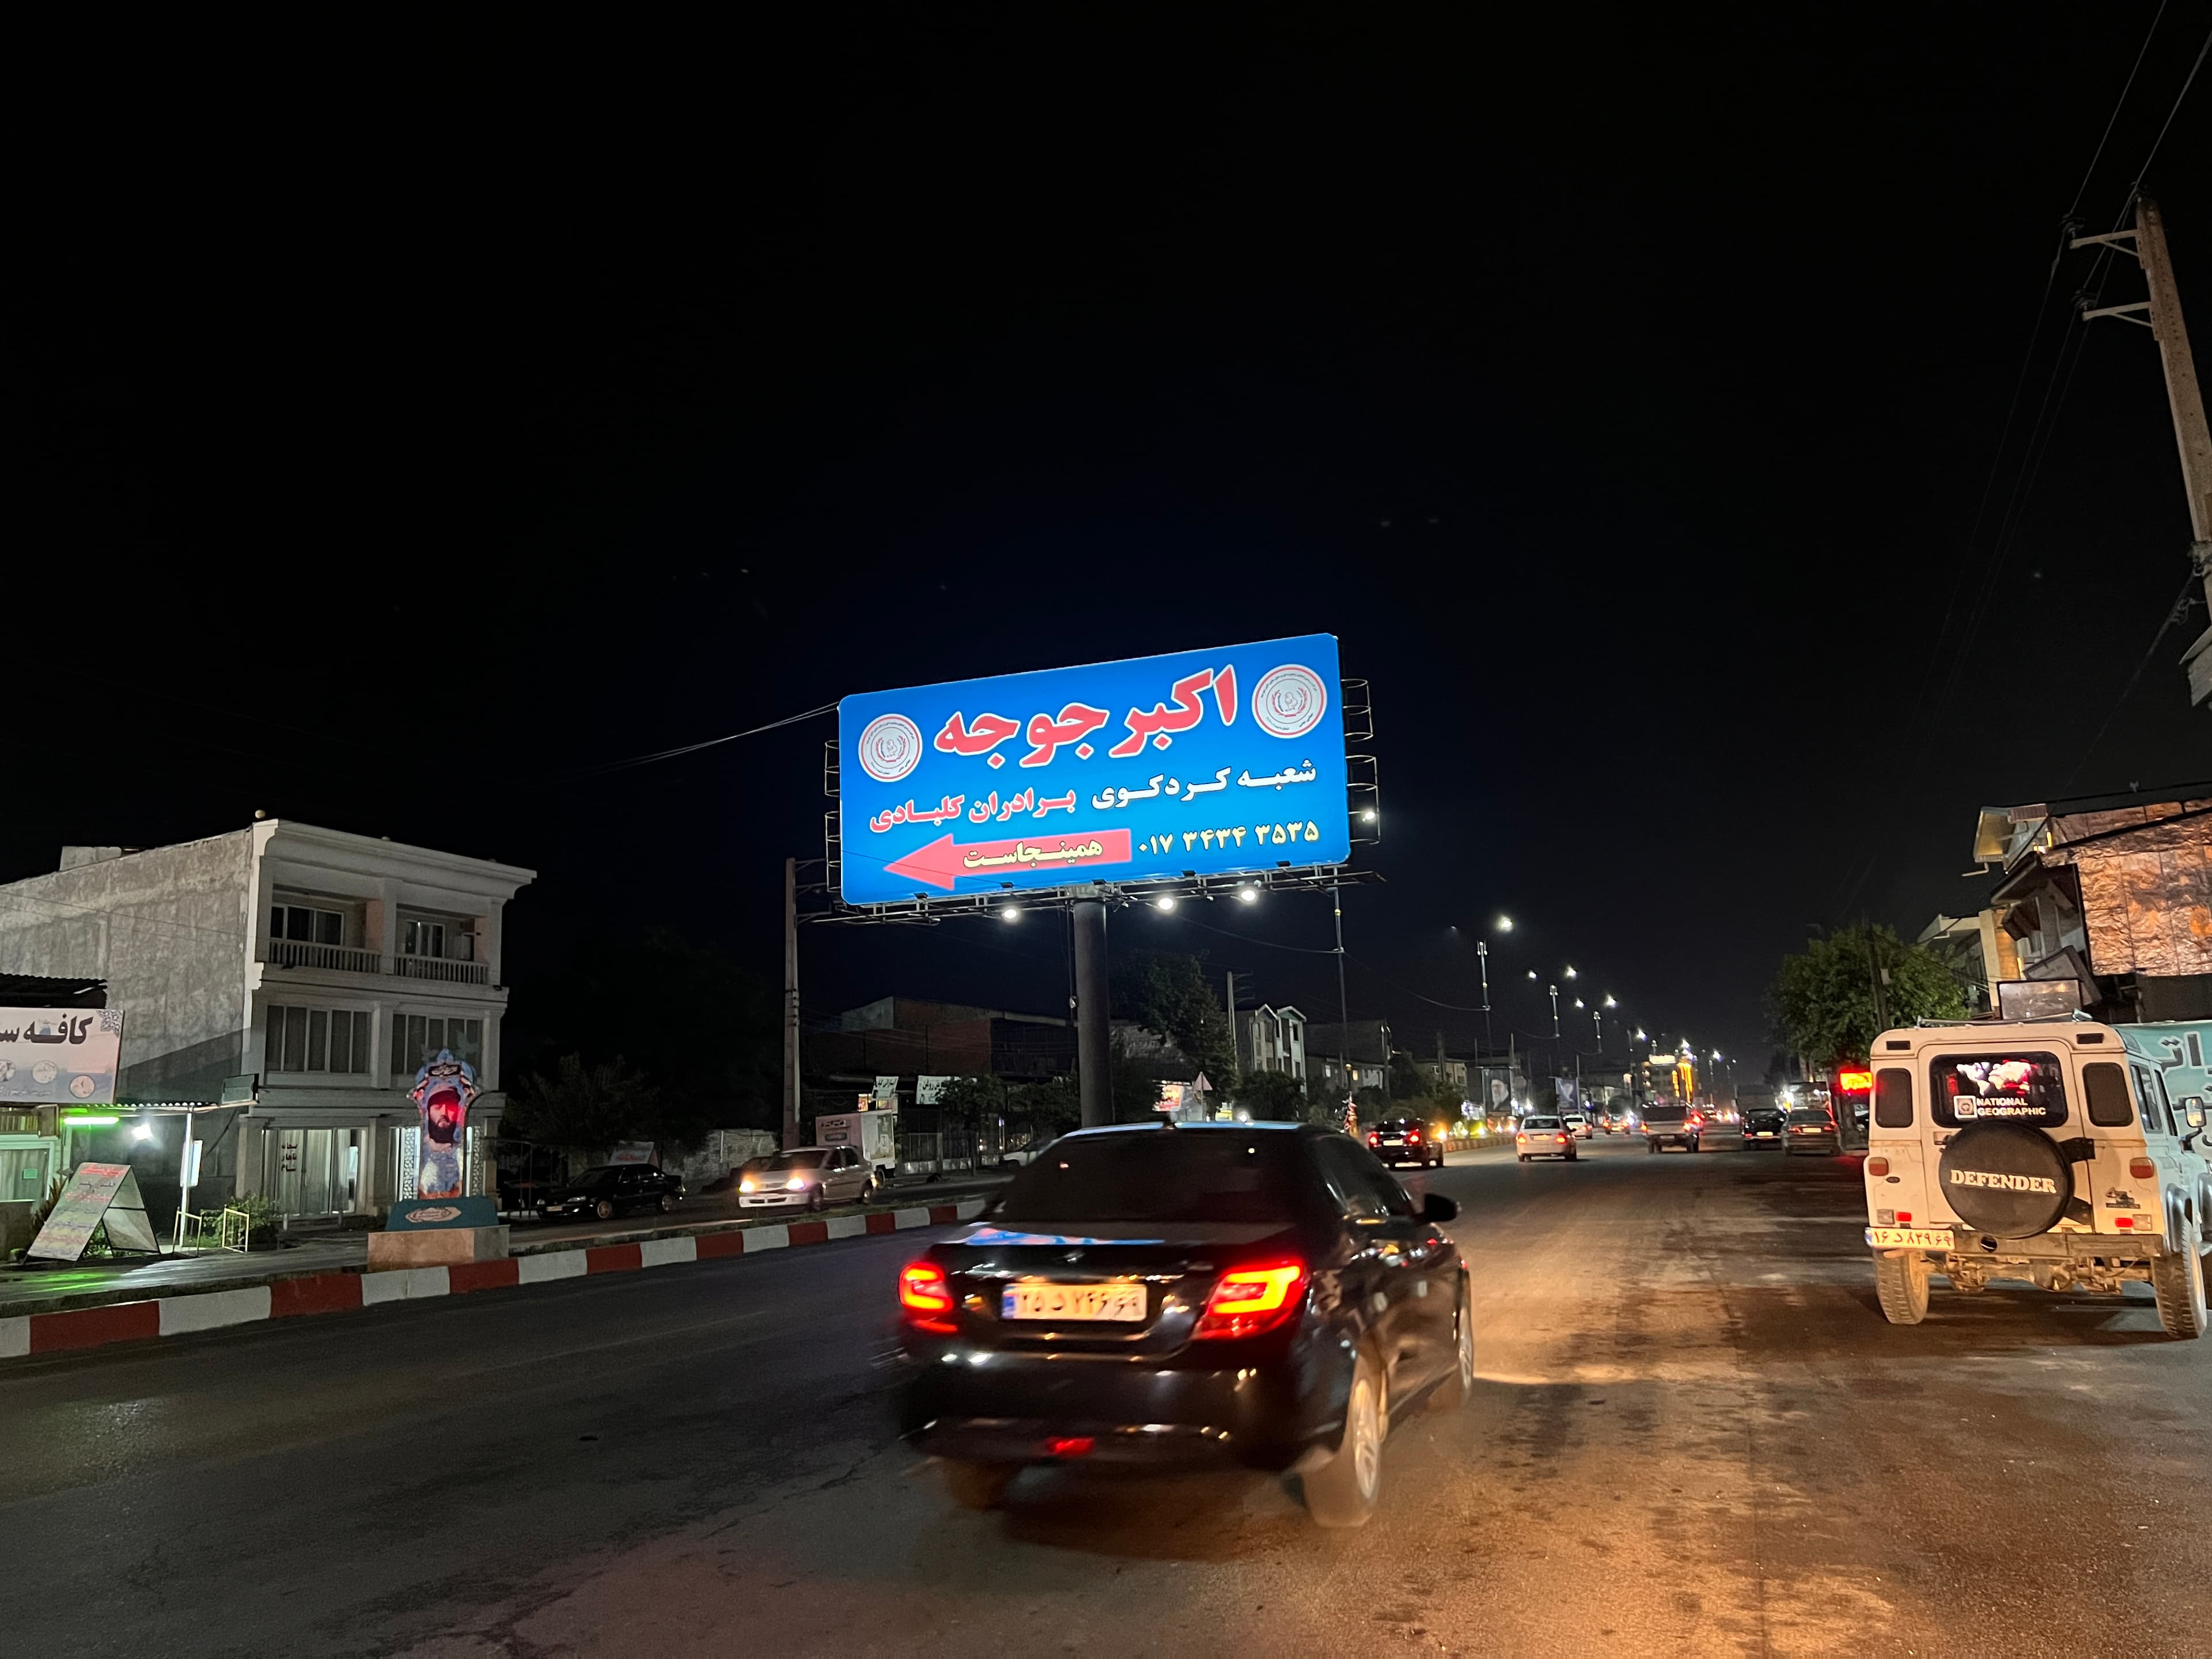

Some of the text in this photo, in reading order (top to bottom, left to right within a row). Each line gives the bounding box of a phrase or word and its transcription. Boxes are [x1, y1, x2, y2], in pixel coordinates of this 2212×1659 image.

[934, 664, 1237, 769] اکبر جوجه
[1092, 759, 1317, 809] شعبه کردکوی
[870, 787, 1076, 833] برادران کلبادی
[963, 839, 1103, 868] همینجاست
[1138, 820, 1319, 855] ۰۱۷ ۳۴۳۴ ۳۵۳۵
[23, 1013, 94, 1045] کافه
[1976, 1097, 2028, 1106] NATIONAL
[1977, 1107, 2046, 1116] GEOGRAPHIC
[1950, 1169, 2056, 1194] DEFENDER
